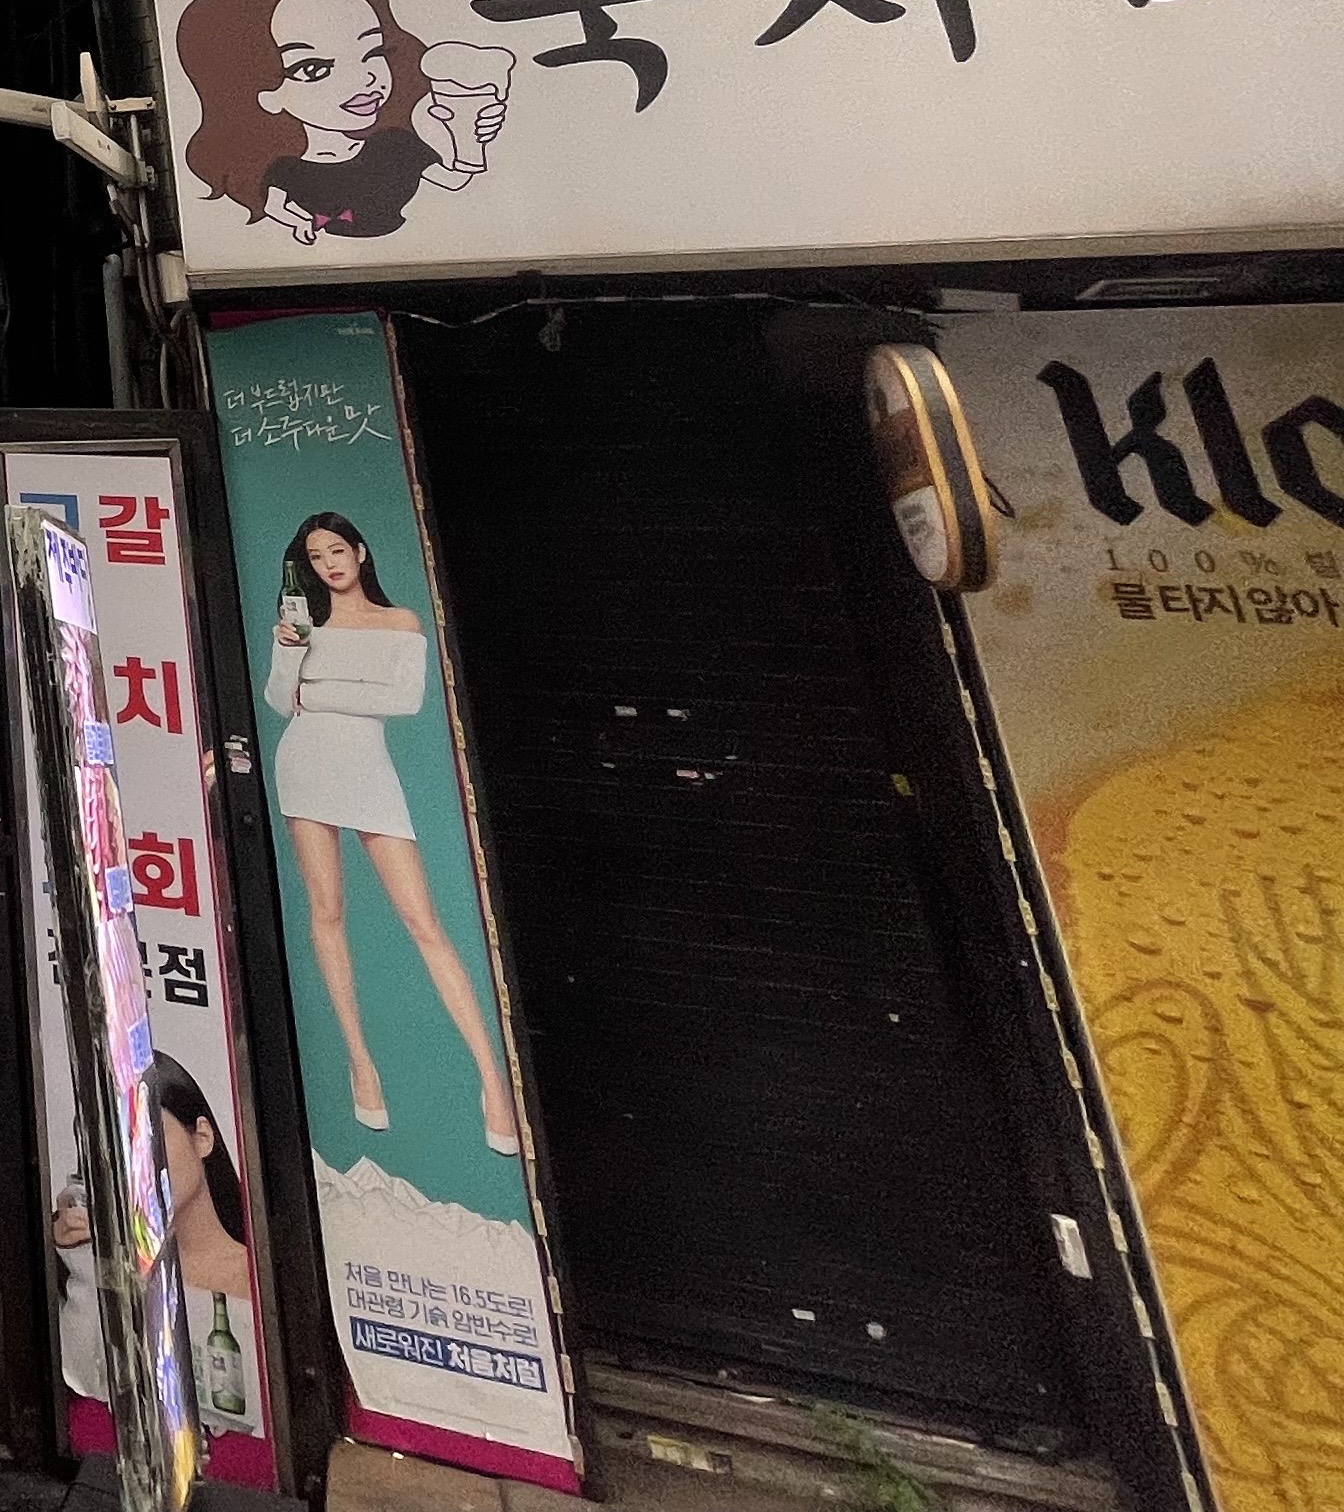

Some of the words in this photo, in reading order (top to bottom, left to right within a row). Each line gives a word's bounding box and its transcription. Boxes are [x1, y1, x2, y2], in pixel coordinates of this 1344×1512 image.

[223, 390, 244, 409] 더
[230, 427, 252, 446] 더
[344, 404, 393, 446] 맛
[344, 1261, 382, 1288] 처음
[387, 1270, 447, 1301] 만나는
[347, 1287, 404, 1319] 대관령
[452, 1310, 538, 1347] 암반수로
[354, 1322, 443, 1365] 새로워진
[447, 1341, 542, 1389] 처음처럼
